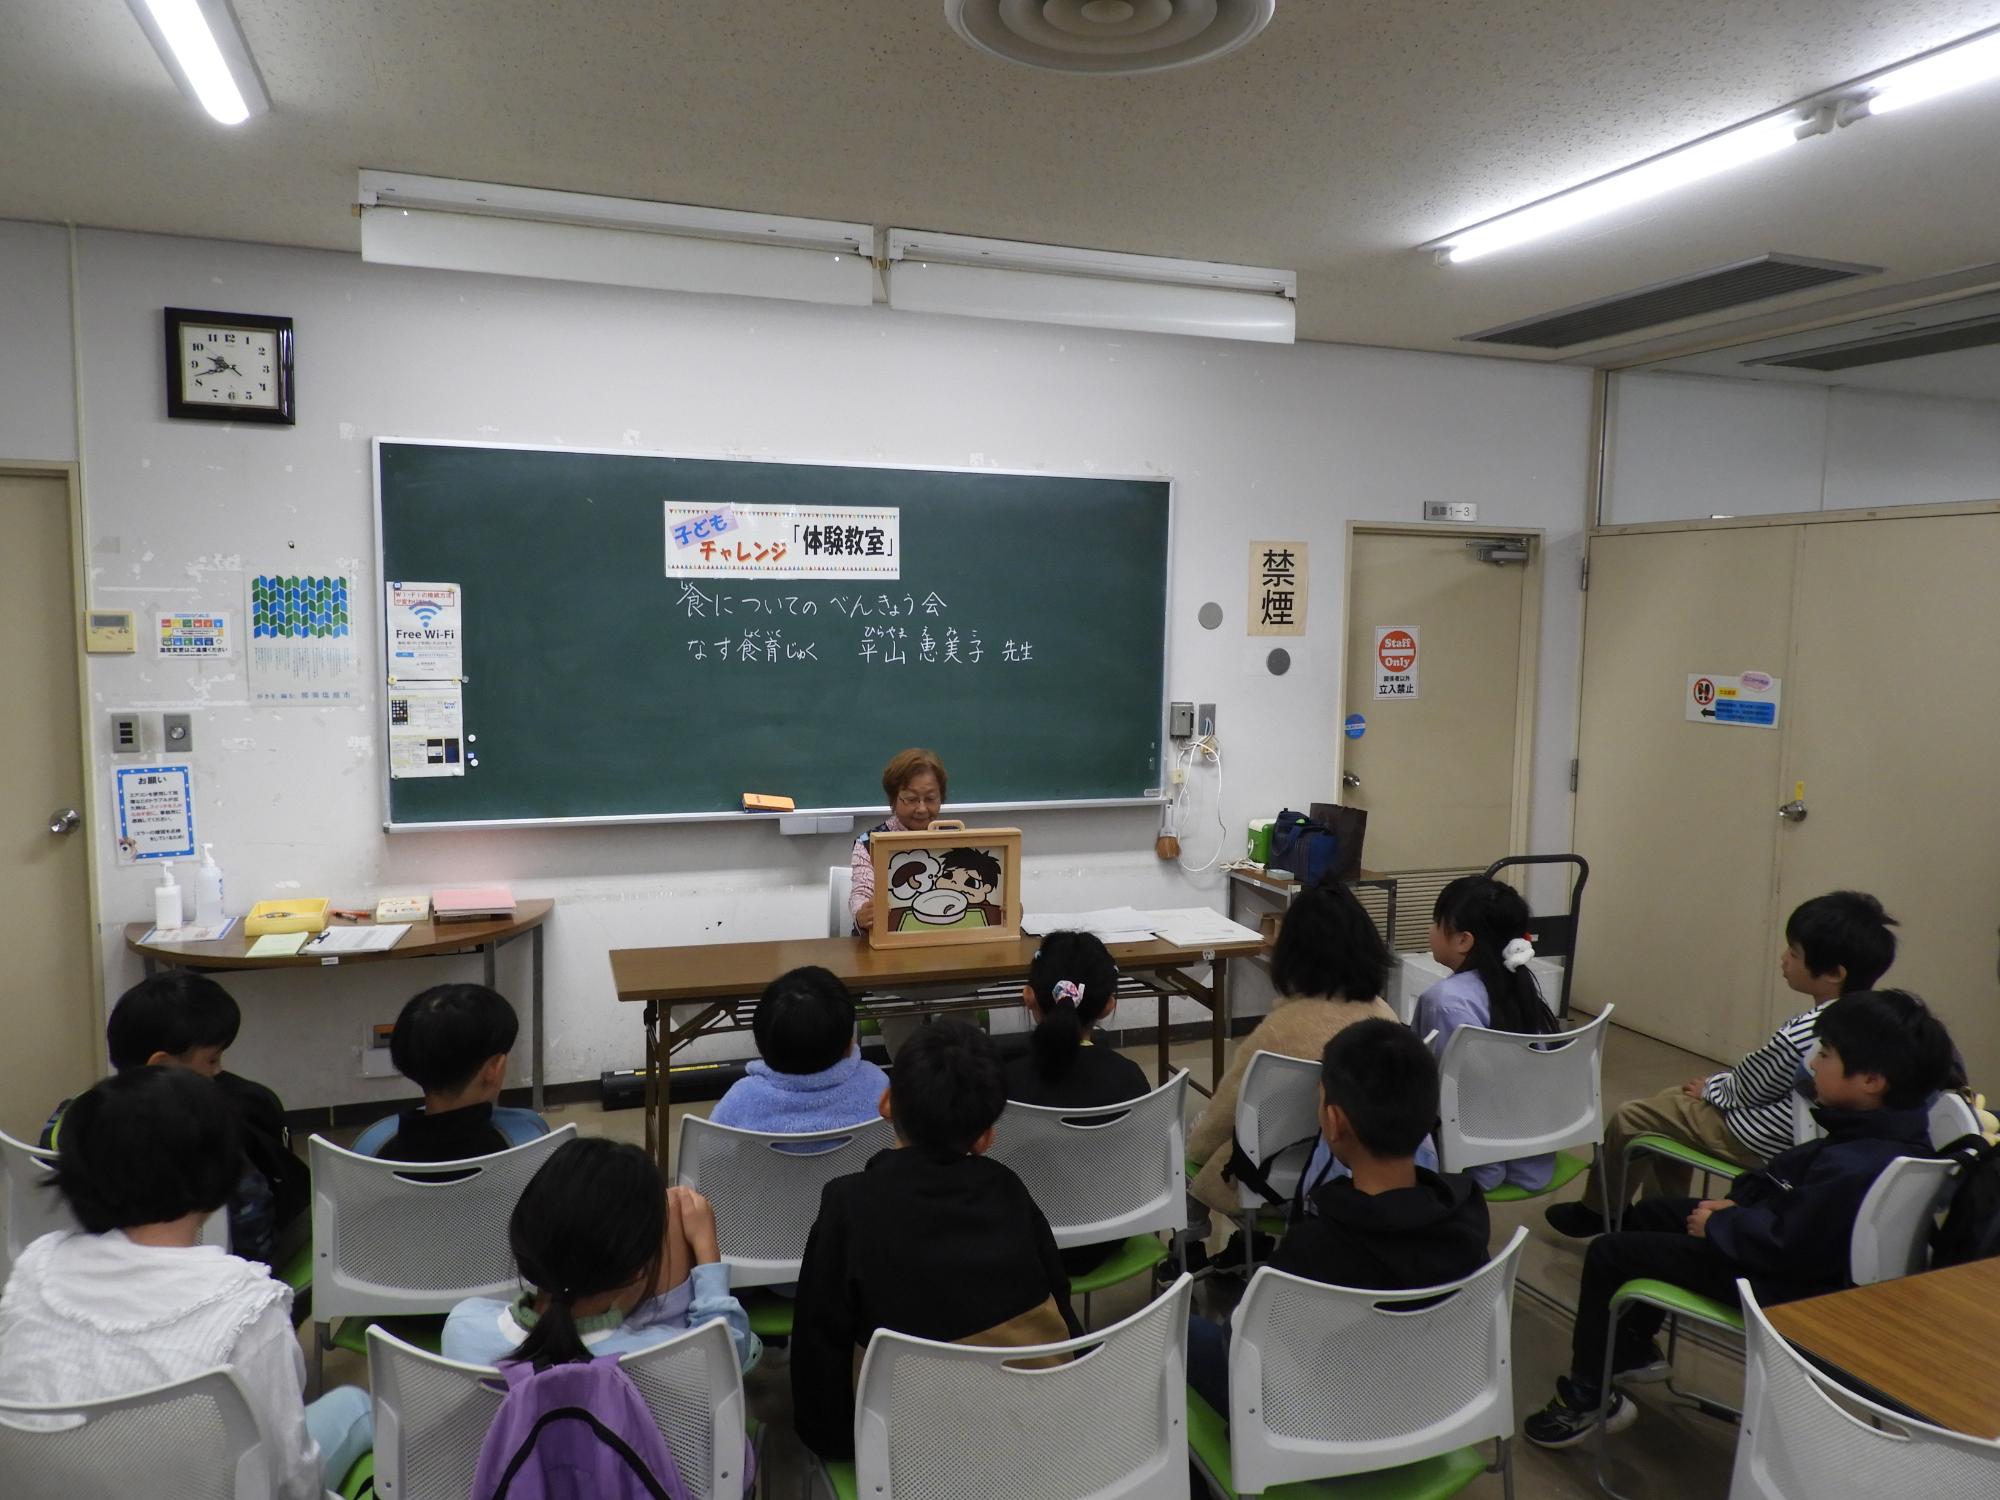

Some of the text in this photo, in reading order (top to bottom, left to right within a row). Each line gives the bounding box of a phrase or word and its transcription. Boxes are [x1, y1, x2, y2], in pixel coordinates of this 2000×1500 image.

[225, 334, 236, 343] 12
[192, 343, 204, 352] 10
[258, 346, 266, 356] 2
[191, 360, 199, 369] 9
[262, 366, 270, 374] 3
[674, 513, 728, 546] 子ども
[793, 523, 894, 557] 「体験教室」
[699, 540, 789, 563] チャレンジ
[1261, 549, 1295, 625] 禁煙
[396, 628, 455, 640] Free Wi-Fi
[1384, 638, 1412, 649] Staff
[1385, 656, 1411, 669] Only
[1379, 683, 1415, 695] 立入禁止
